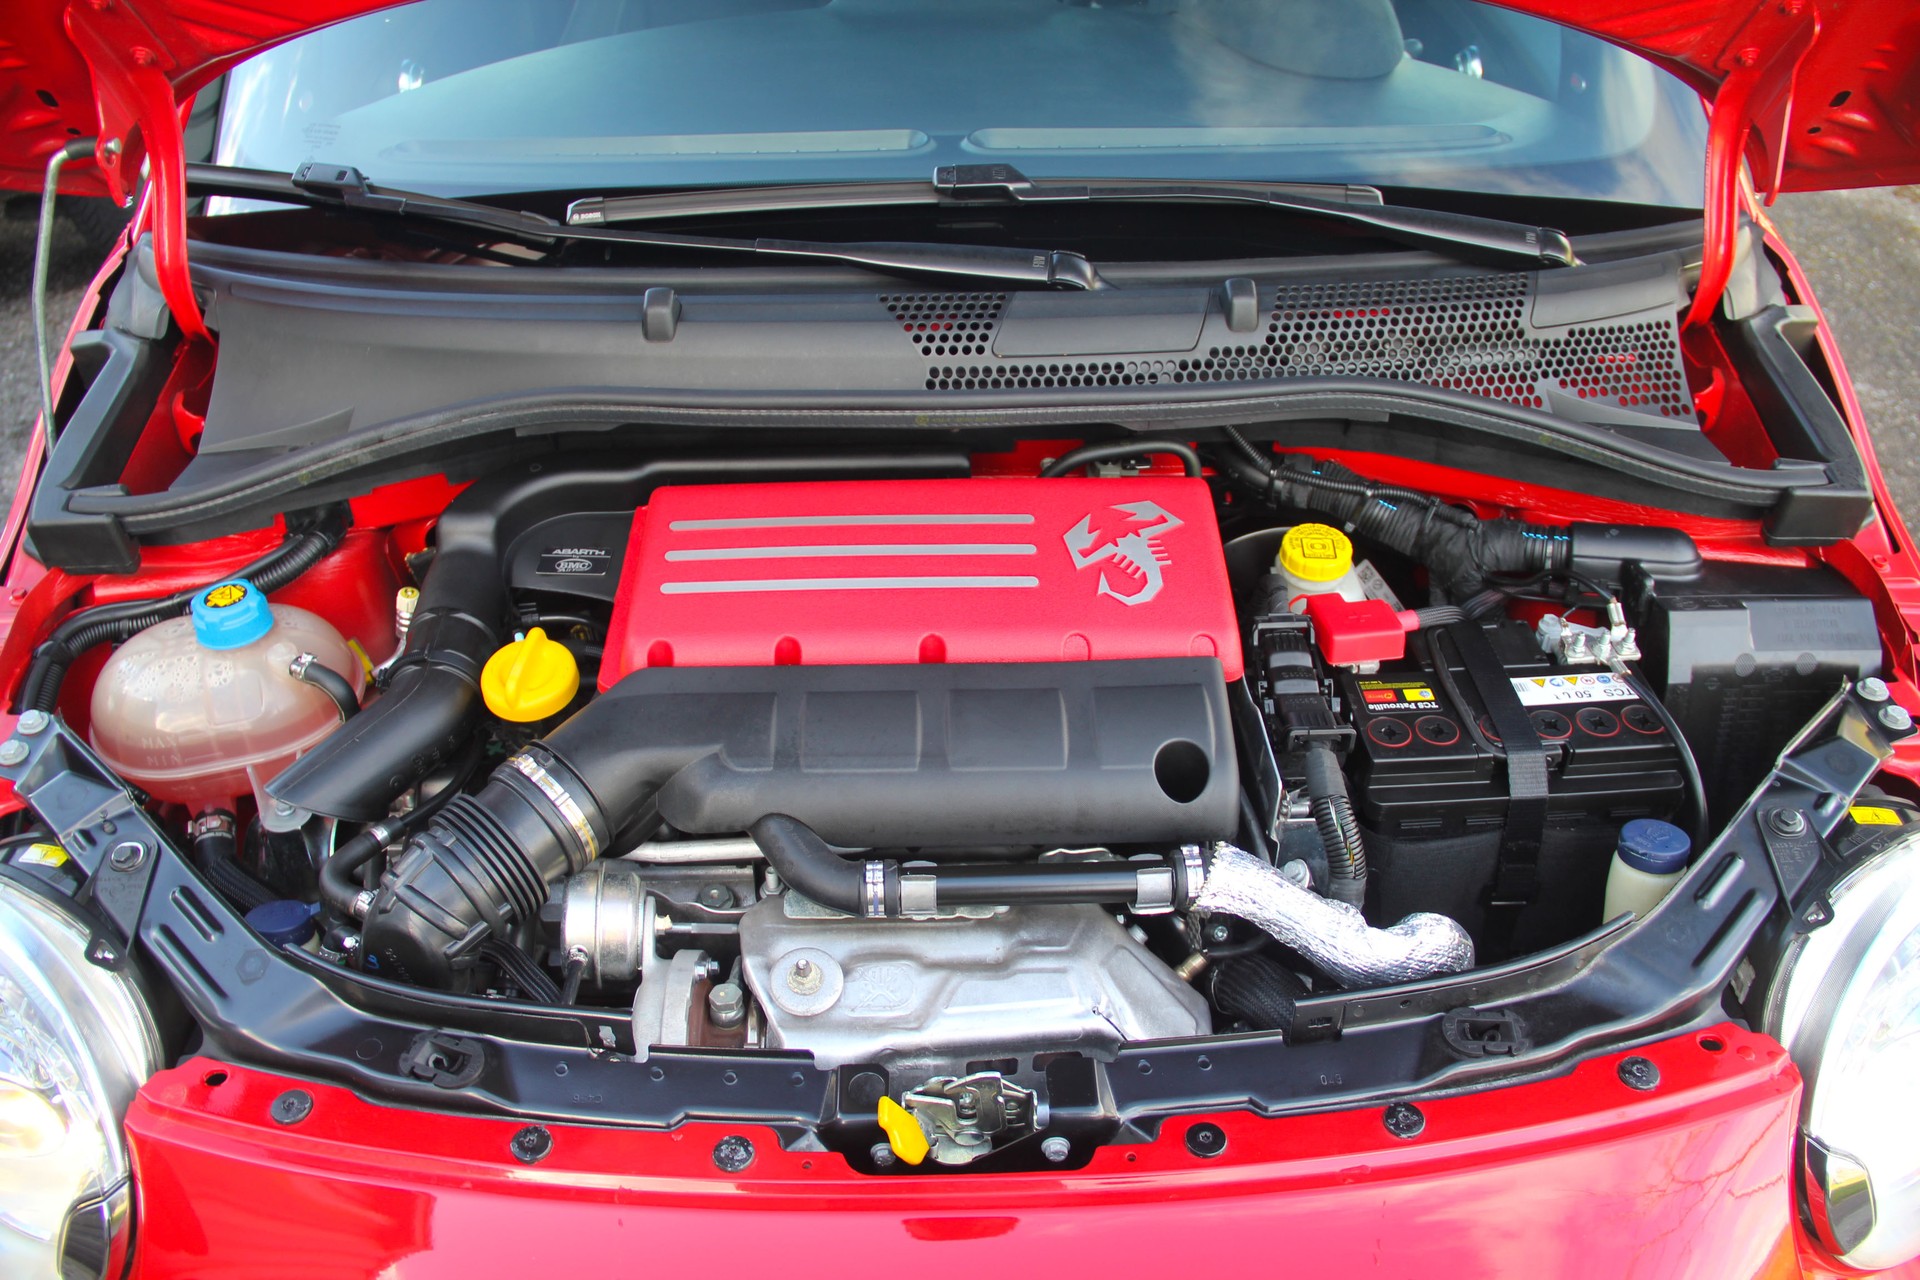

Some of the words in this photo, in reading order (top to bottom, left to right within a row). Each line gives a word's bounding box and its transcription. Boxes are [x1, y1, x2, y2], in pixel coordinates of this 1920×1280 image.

[552, 548, 605, 556] ABARTH
[1575, 690, 1592, 699] 50
[1603, 688, 1633, 697] TCS
[1368, 703, 1416, 711] Patrouille
